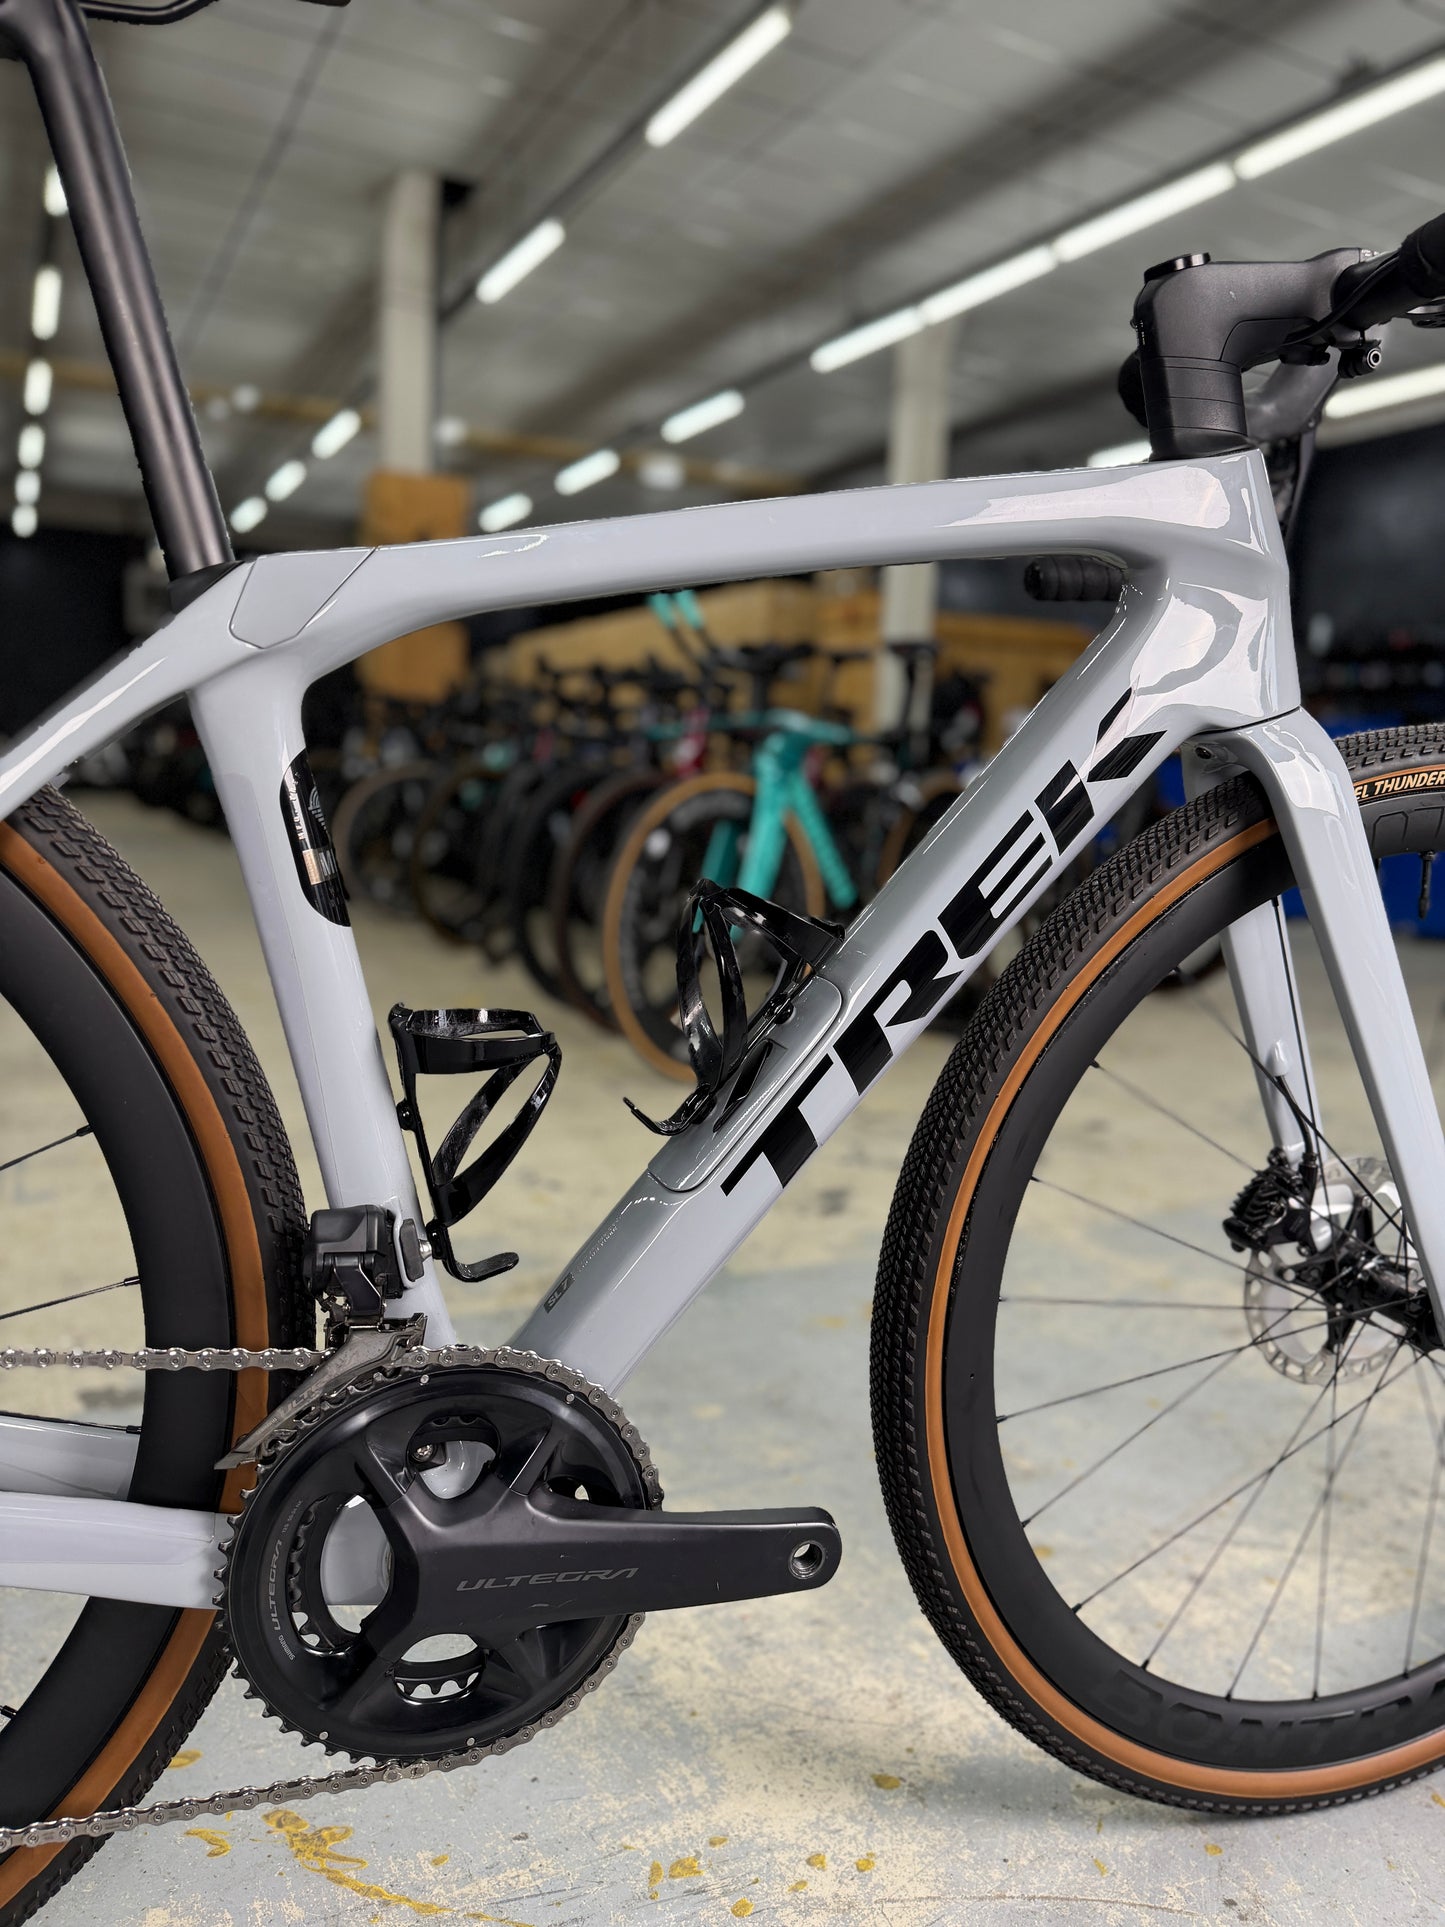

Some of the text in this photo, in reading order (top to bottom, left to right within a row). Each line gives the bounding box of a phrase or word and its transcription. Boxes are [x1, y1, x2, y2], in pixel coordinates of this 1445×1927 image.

[720, 687, 1168, 1197] TREK
[547, 1291, 562, 1307] SL
[268, 1539, 283, 1631] ULTEGRA
[456, 1567, 640, 1592] ULTEGRA
